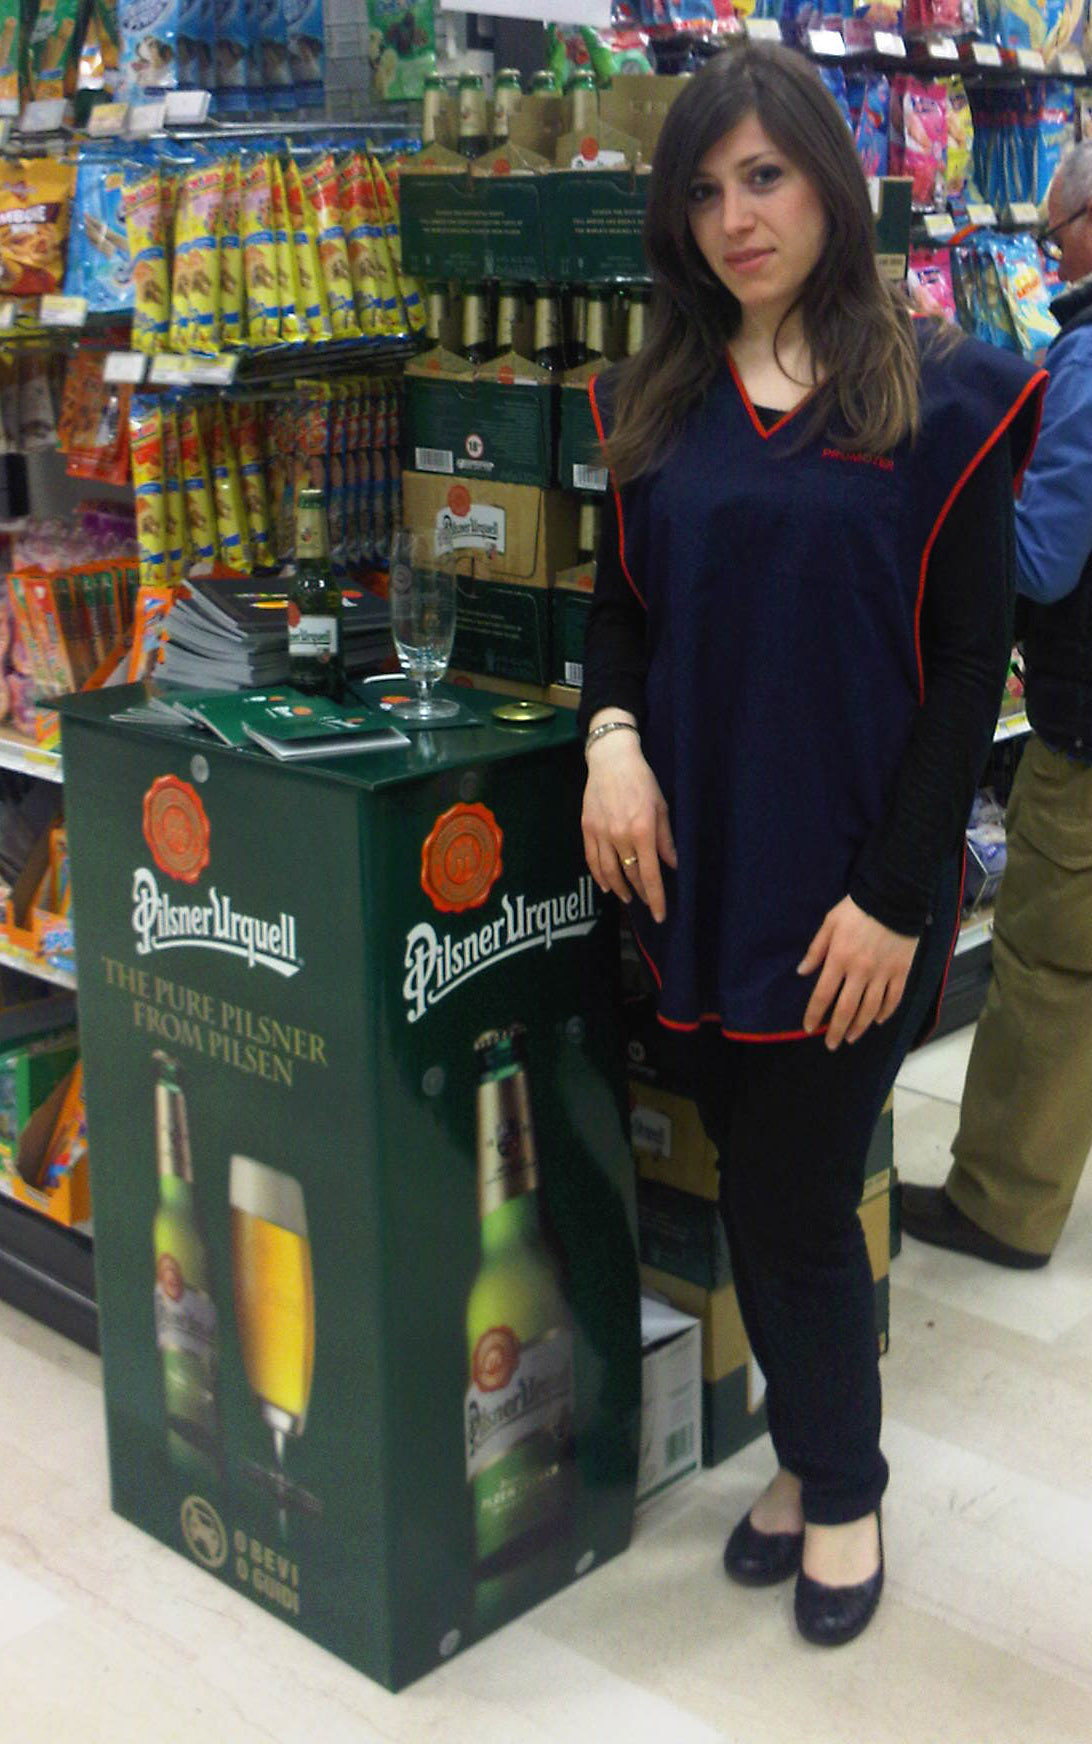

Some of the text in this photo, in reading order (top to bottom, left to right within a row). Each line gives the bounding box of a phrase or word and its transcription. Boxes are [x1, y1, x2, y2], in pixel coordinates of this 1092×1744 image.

[132, 867, 297, 967] Pilsner Urquell
[402, 874, 594, 1024] Pilsner Urquell
[102, 955, 328, 1068] THE PURE PILSNER
[133, 1001, 294, 1087] FROM PILSEN
[249, 1538, 299, 1590] BEVI
